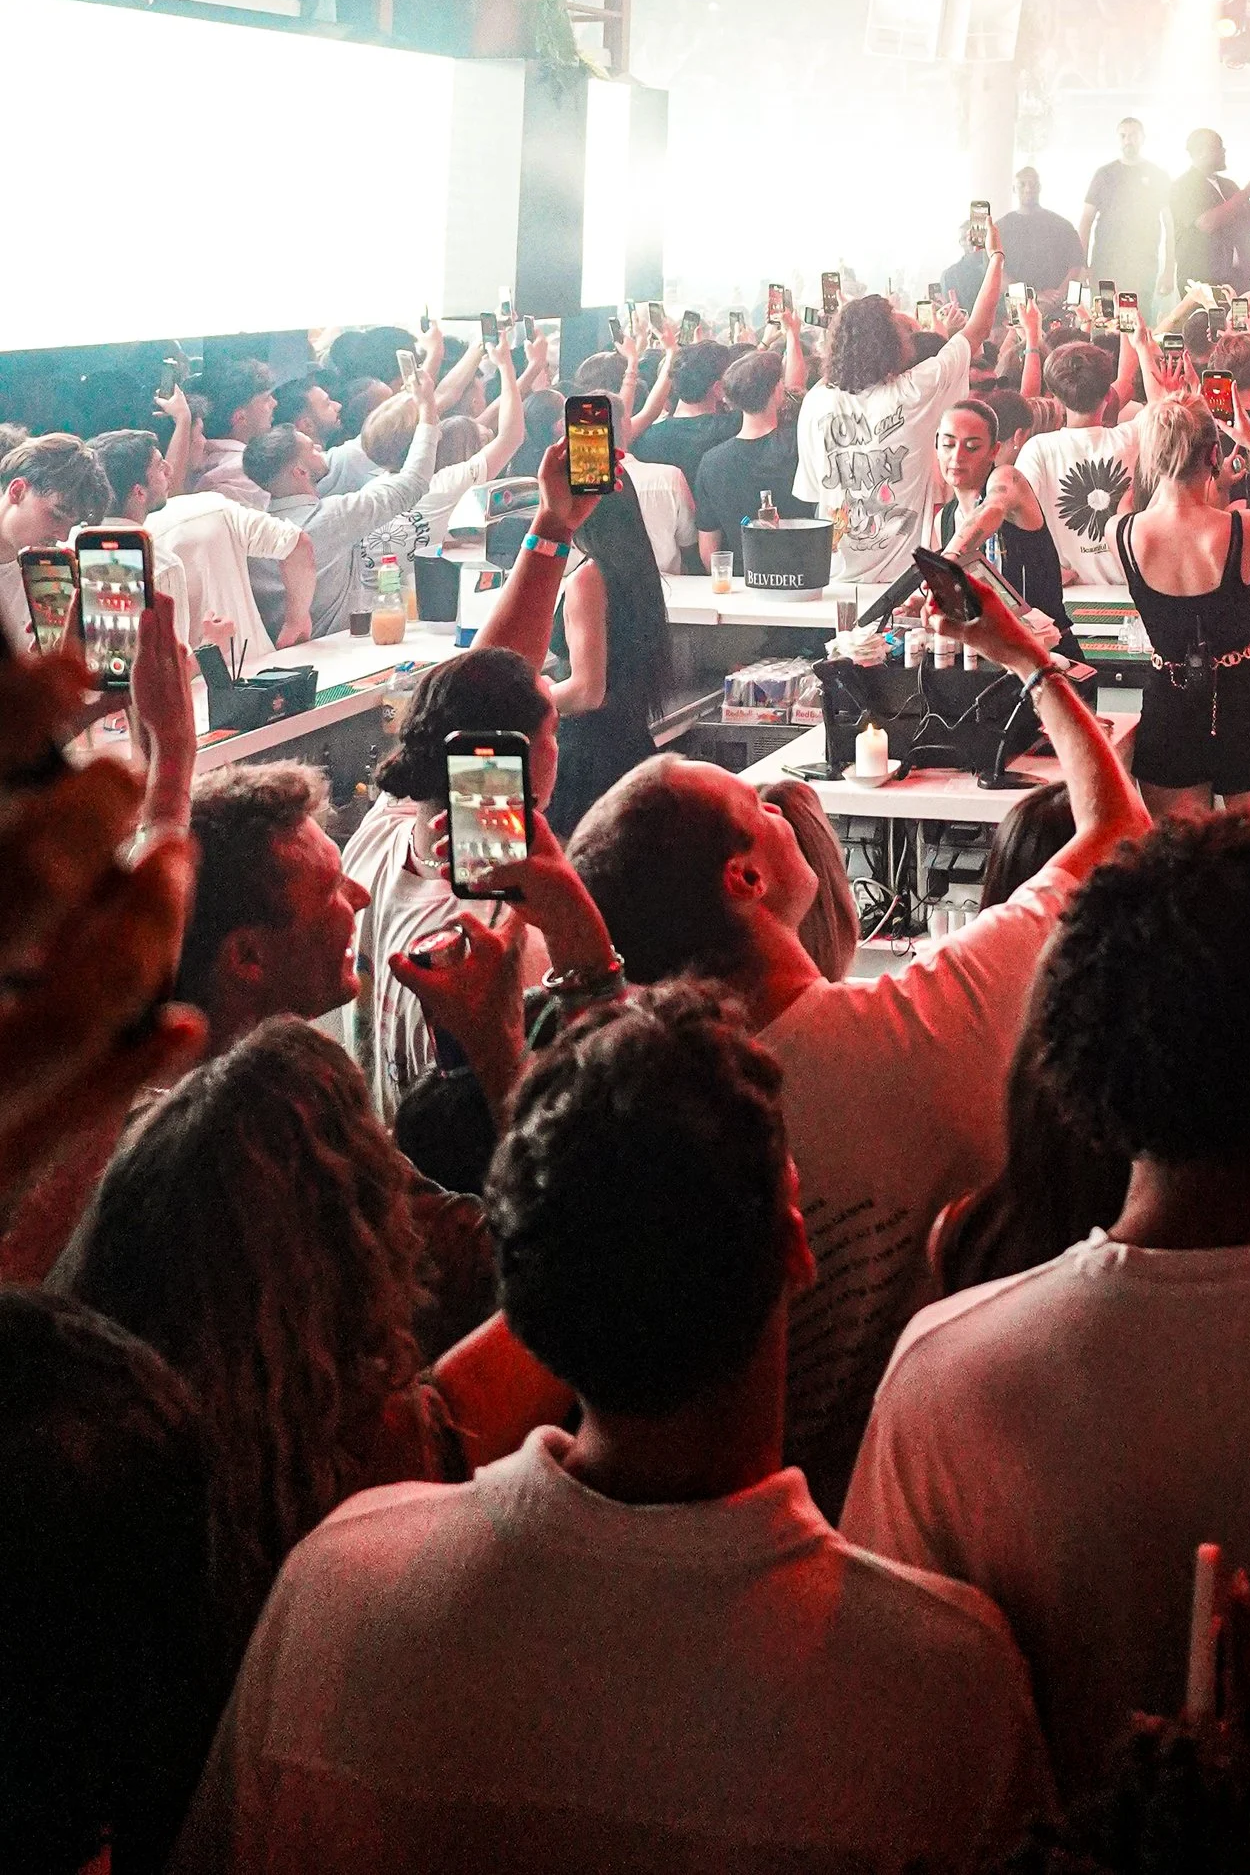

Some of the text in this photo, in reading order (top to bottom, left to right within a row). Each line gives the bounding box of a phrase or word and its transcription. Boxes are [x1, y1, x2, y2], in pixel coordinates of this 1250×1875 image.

[818, 412, 872, 452] TOM
[822, 445, 909, 490] JERRY
[747, 569, 804, 588] BELVEDERE
[796, 709, 809, 718] Red
